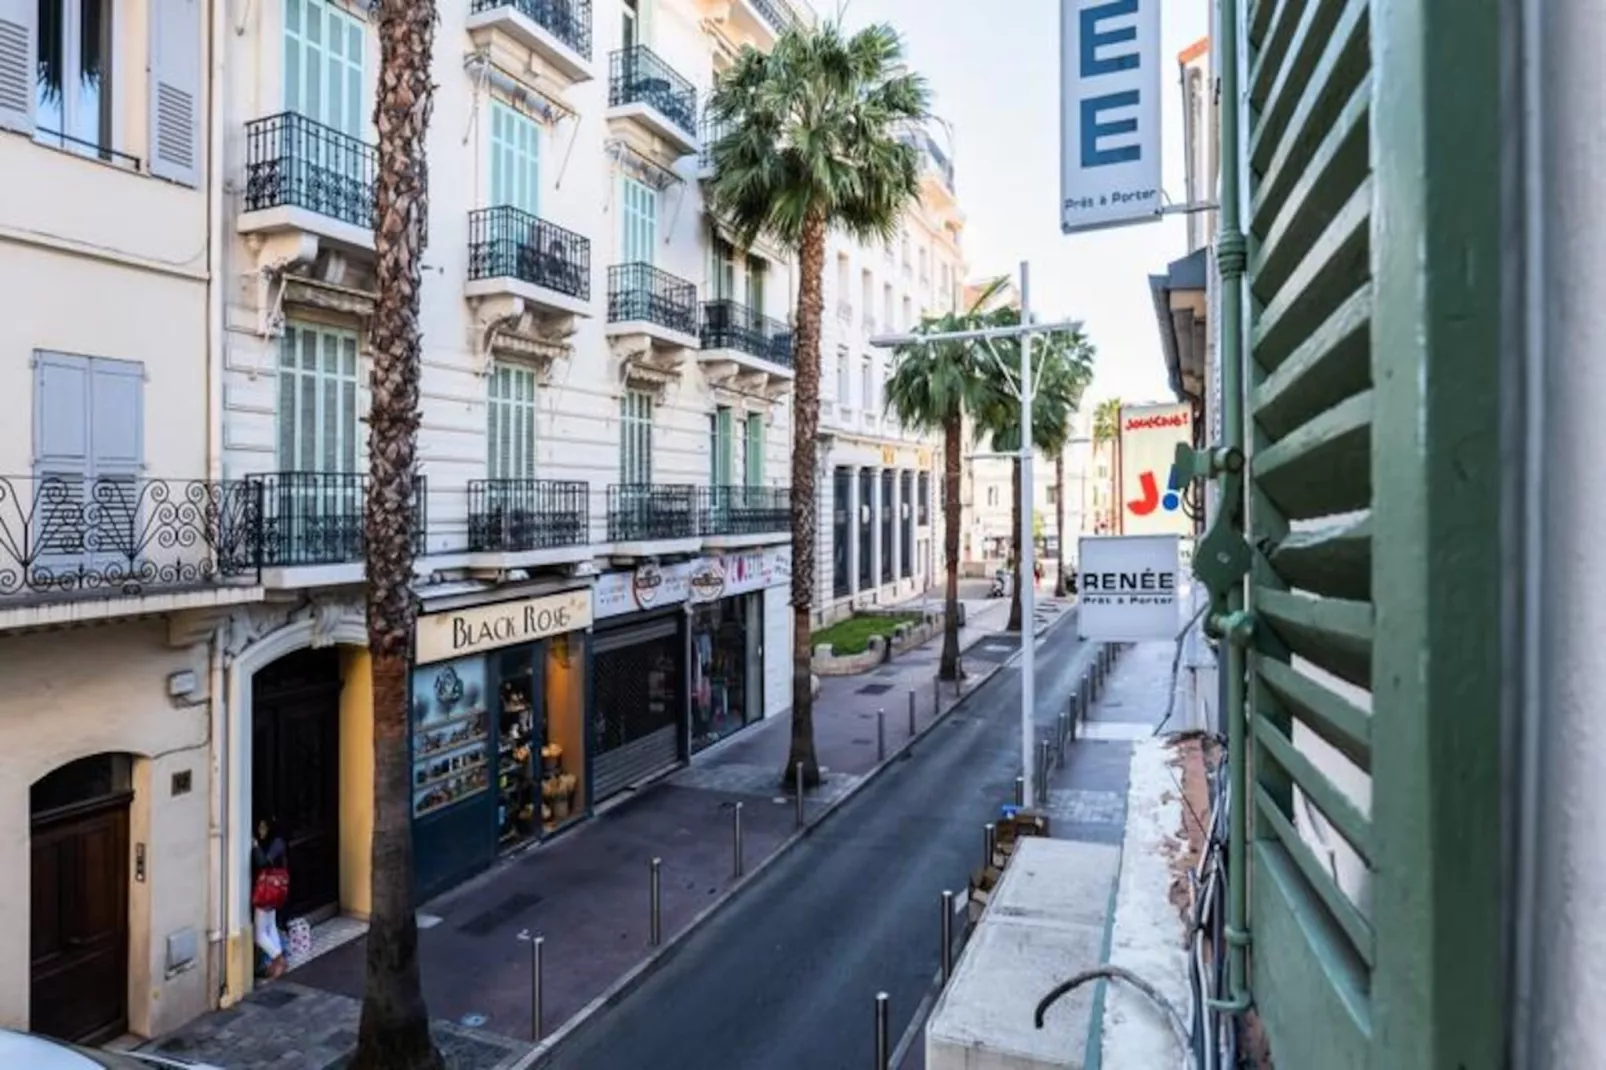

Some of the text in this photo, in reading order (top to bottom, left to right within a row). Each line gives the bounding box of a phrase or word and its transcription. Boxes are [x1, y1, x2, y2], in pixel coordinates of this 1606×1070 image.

[1112, 189, 1157, 203] Porter
[1083, 567, 1174, 590] RENÉE
[1130, 597, 1173, 605] Porter
[453, 605, 570, 649] BLACK ROSE
